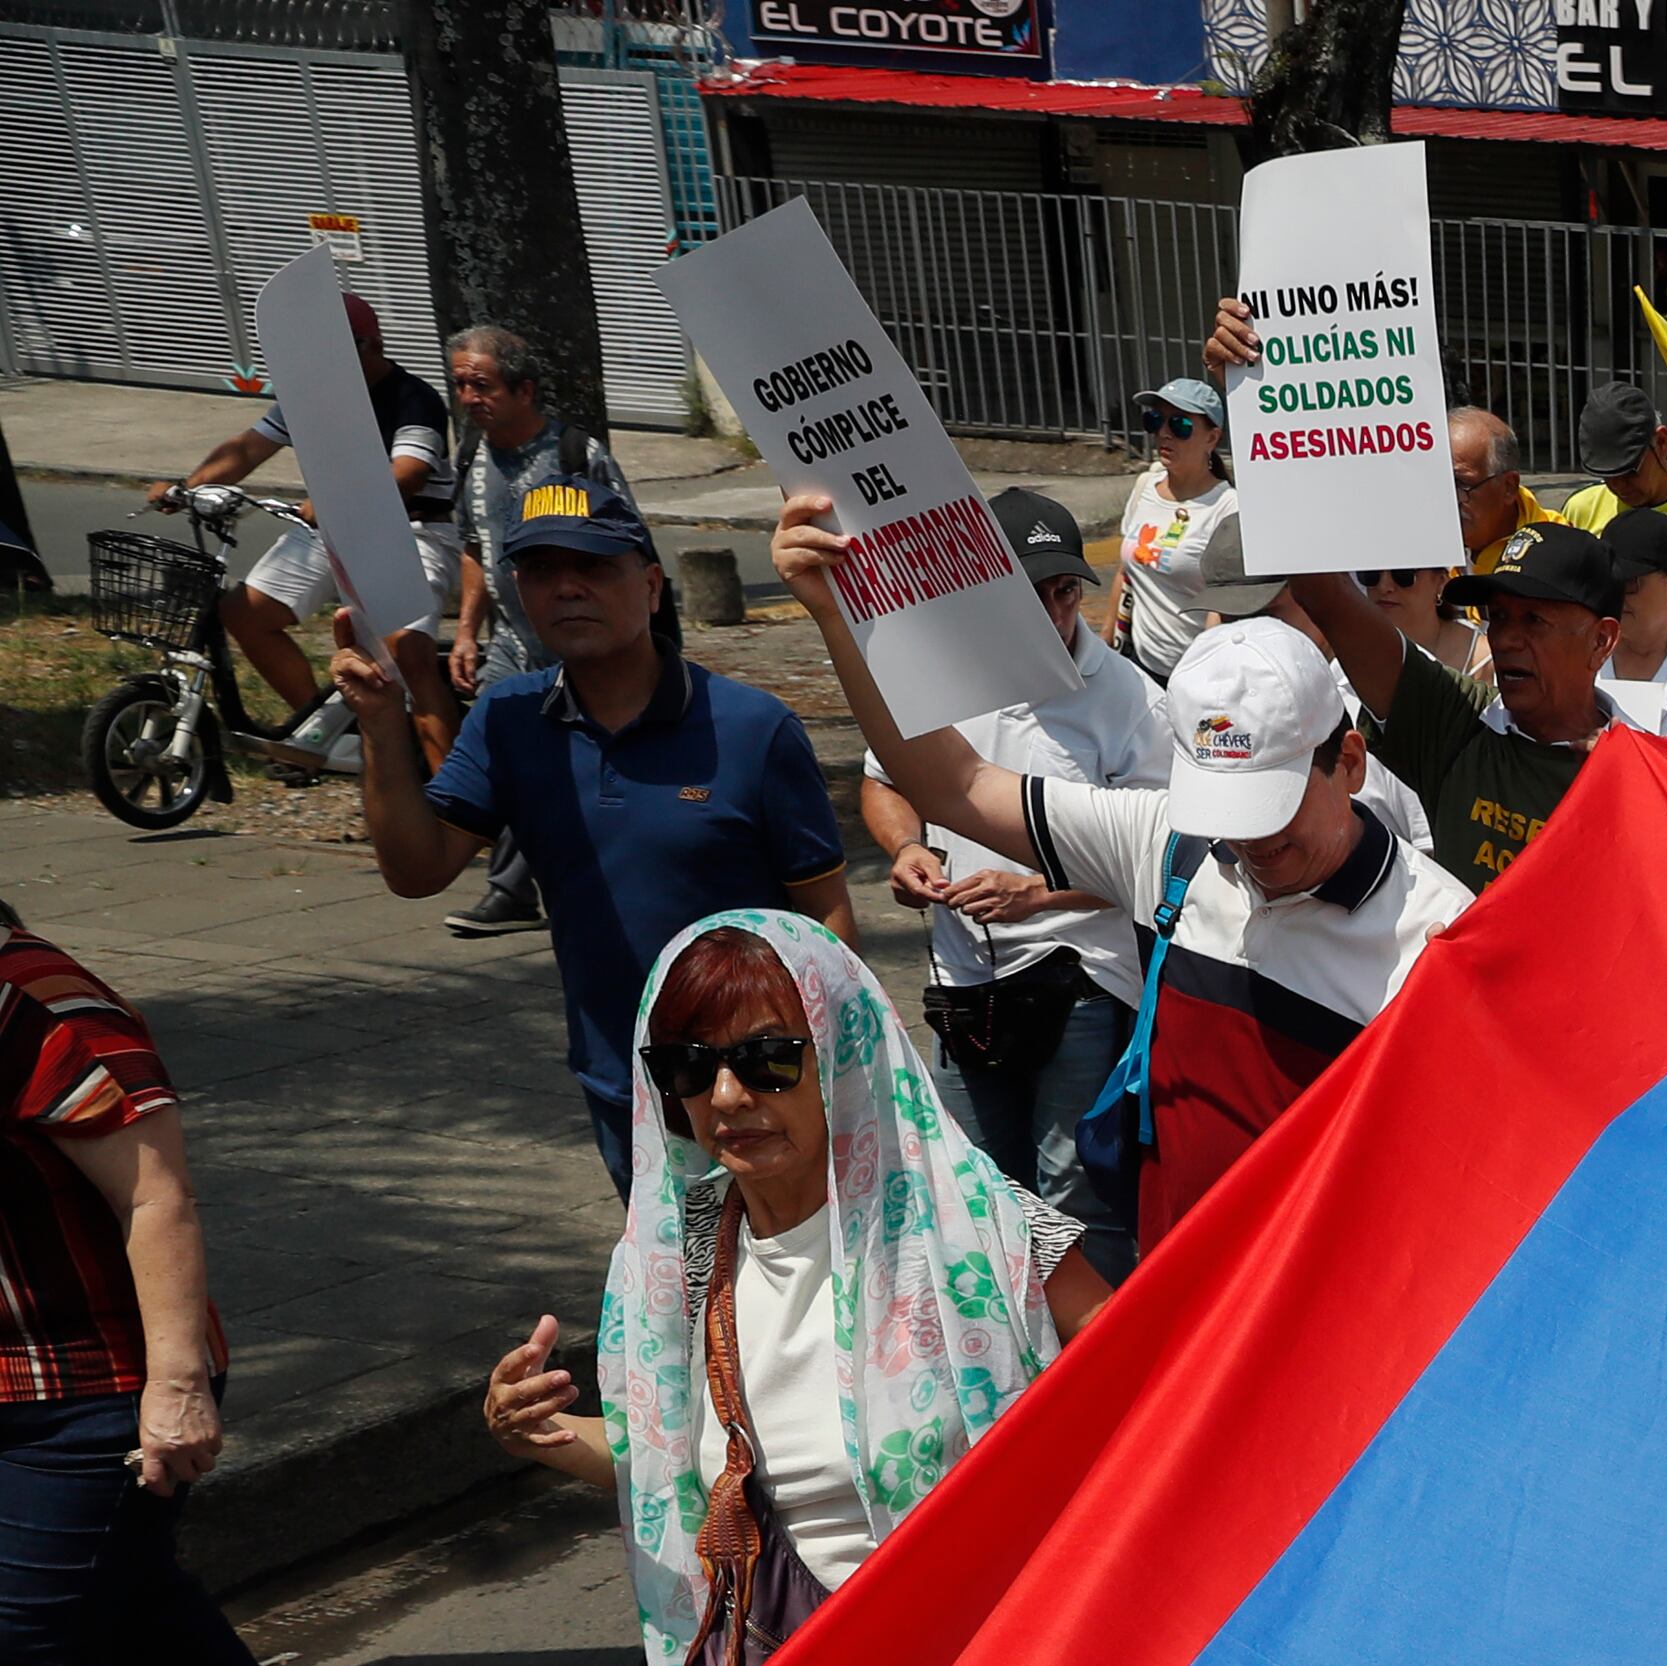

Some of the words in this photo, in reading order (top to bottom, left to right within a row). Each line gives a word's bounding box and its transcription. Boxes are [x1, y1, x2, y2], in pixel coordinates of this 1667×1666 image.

[760, 1, 818, 33] EL
[829, 7, 1004, 47] COYOTE
[1557, 0, 1619, 29] BAR
[1637, 0, 1652, 30] Y
[1557, 43, 1652, 96] EL
[1241, 290, 1270, 320] NI
[1277, 284, 1338, 317] UNO
[1345, 270, 1418, 312] MÁS!
[1386, 326, 1416, 357] NI
[753, 339, 873, 413] GOBIERNO
[1258, 375, 1414, 414] SOLDADOS
[787, 393, 909, 465] CÓMPLICE
[1250, 421, 1434, 461] ASESINADOS
[522, 485, 591, 522] ARMADA
[852, 463, 908, 506] DEL
[829, 495, 1014, 624] NARCOTERRORISMO
[1027, 533, 1062, 545] adidas
